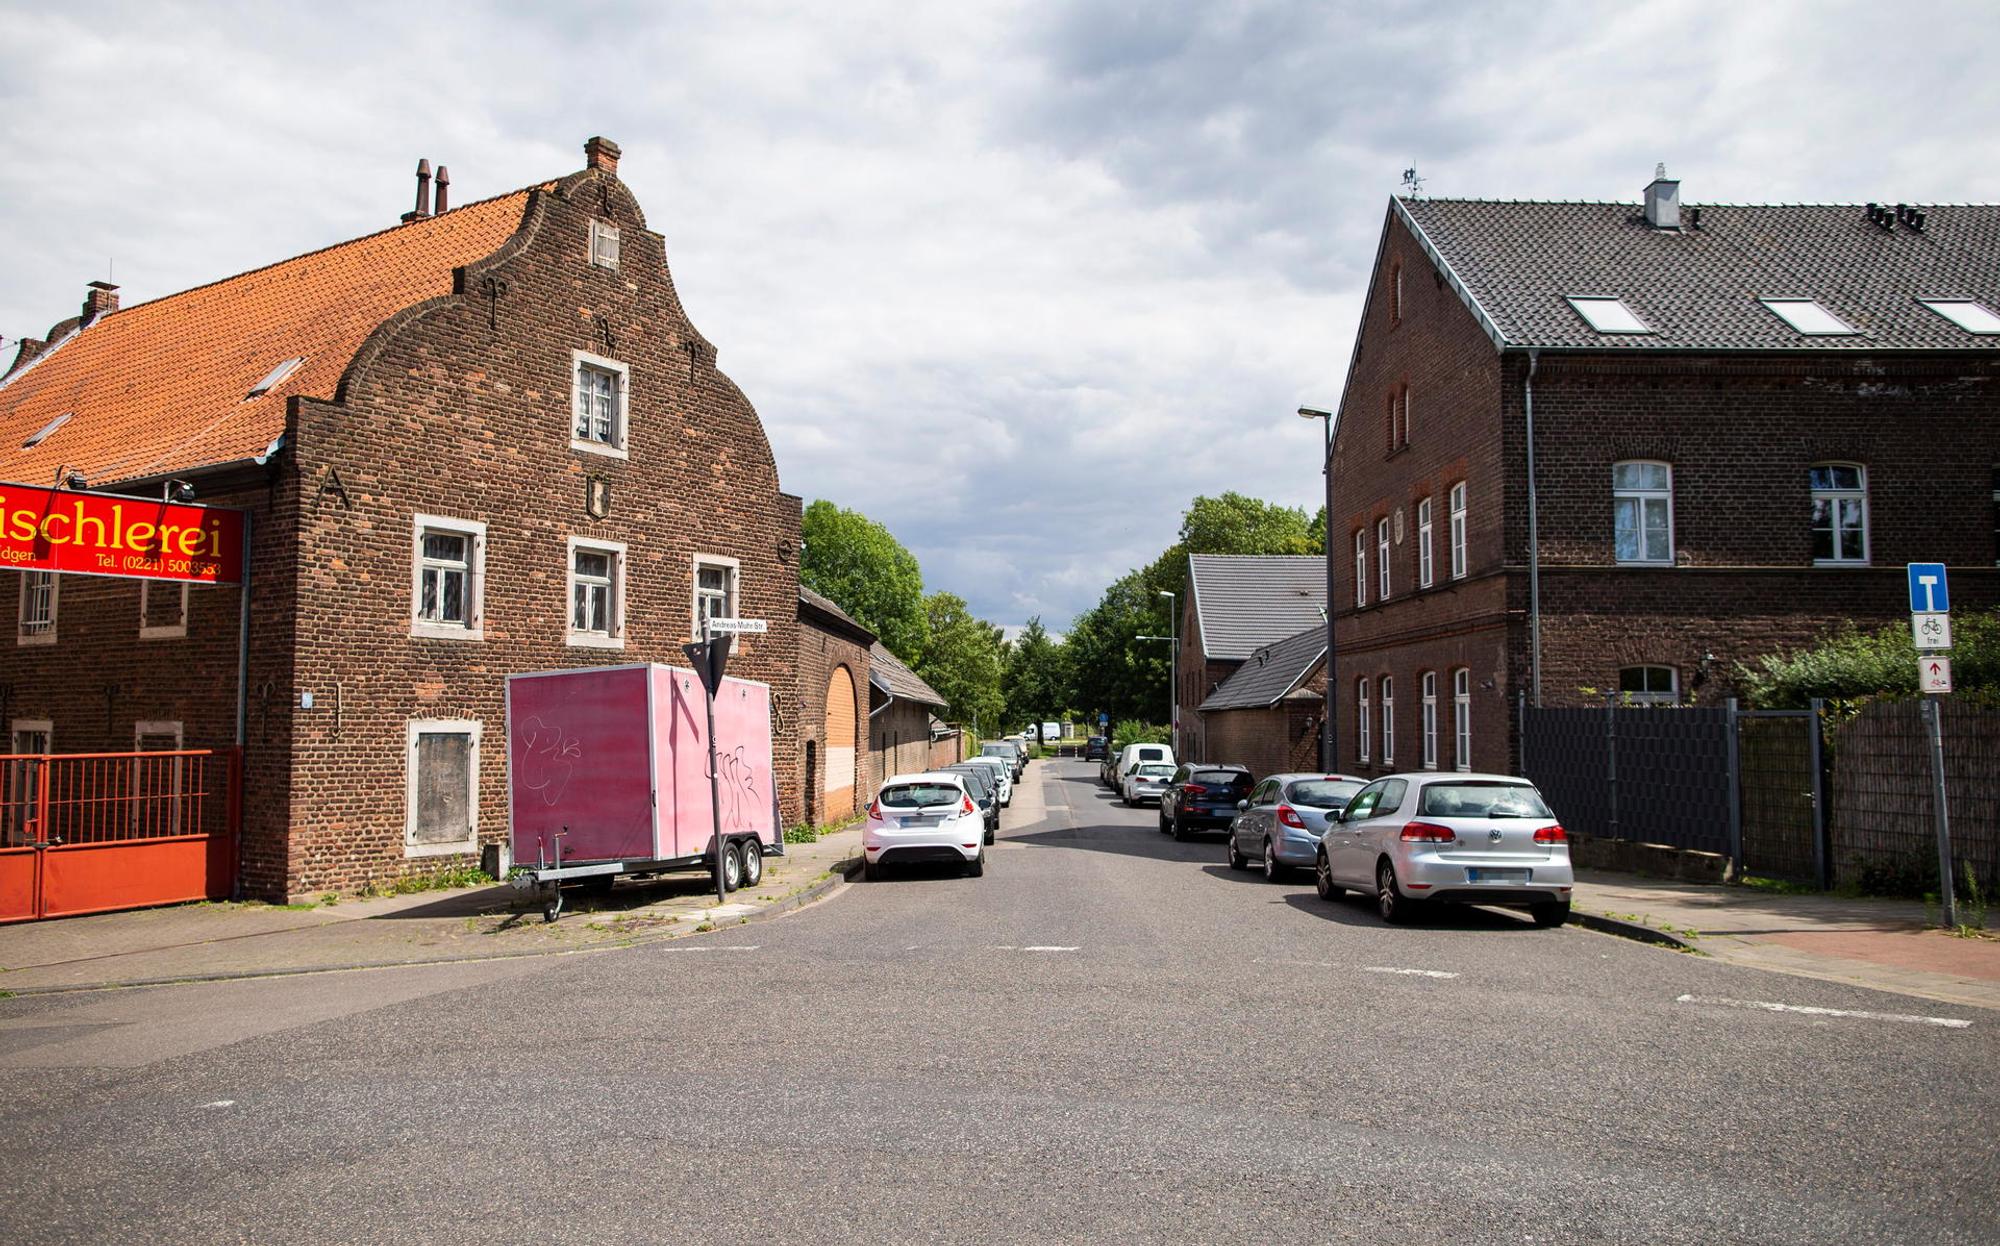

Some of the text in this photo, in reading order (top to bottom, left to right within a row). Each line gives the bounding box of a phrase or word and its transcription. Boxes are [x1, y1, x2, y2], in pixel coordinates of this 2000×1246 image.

[0, 545, 36, 563] dgen
[96, 553, 118, 568] Tel.
[123, 556, 164, 573] (0221)
